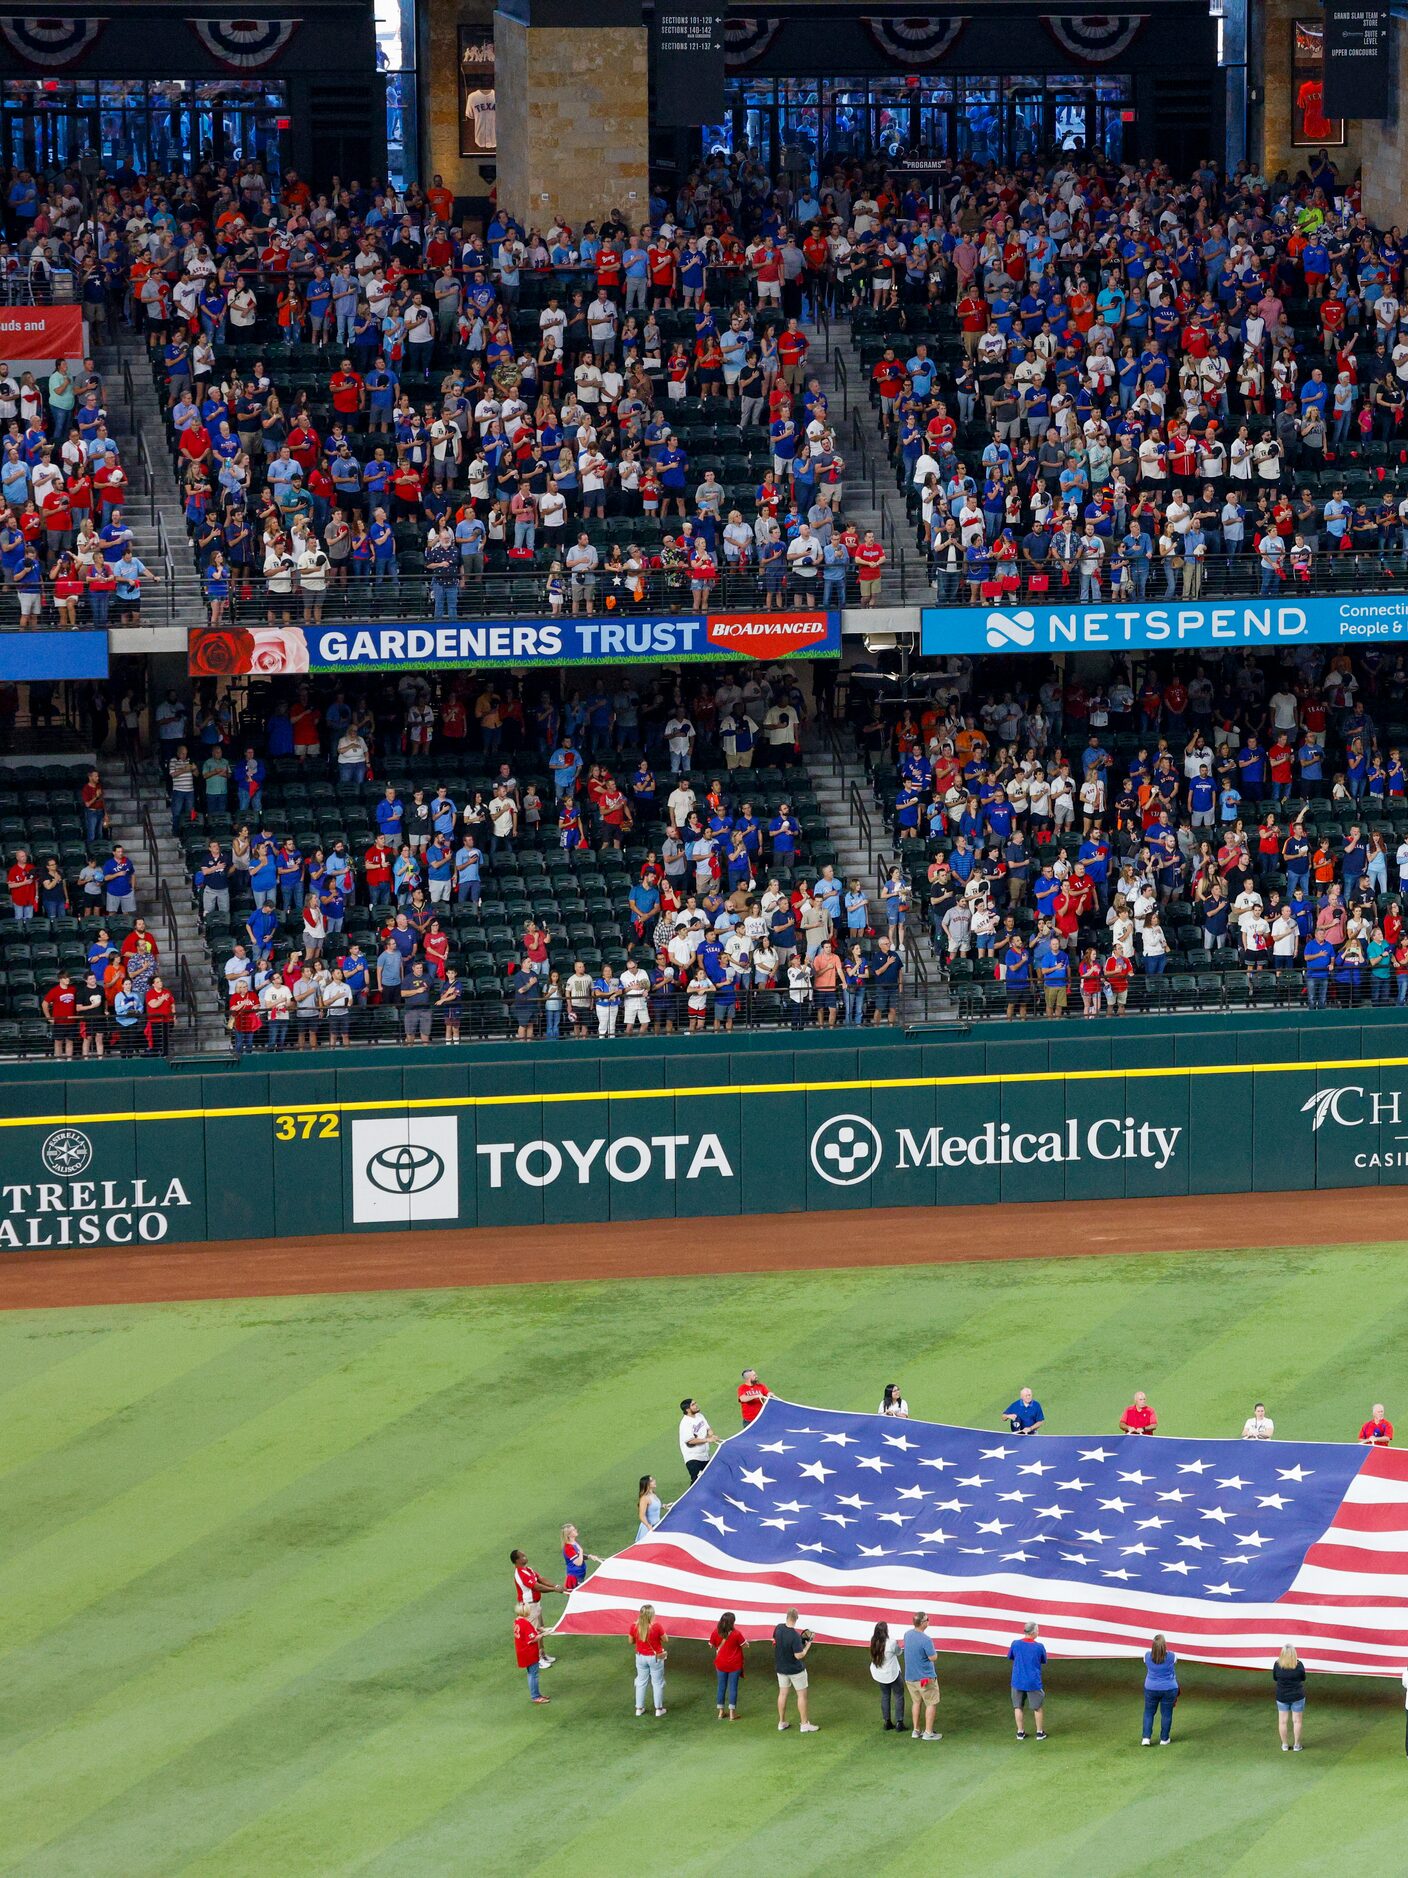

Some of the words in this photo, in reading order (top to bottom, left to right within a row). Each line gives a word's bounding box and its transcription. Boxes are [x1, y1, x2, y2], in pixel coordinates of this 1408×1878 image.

[907, 161, 942, 169] PROGRAMS
[1383, 302, 1393, 314] T
[24, 320, 45, 330] and
[1339, 620, 1388, 638] People
[1392, 620, 1401, 632] &
[320, 625, 562, 661] GARDENERS
[575, 621, 700, 656] TRUST
[275, 1114, 341, 1141] 372
[49, 1132, 86, 1149] ESTRELLA
[896, 1119, 1081, 1169] Medical
[1088, 1117, 1182, 1168] City
[52, 1160, 82, 1173] JALISCO
[476, 1134, 734, 1188] TOYOTA
